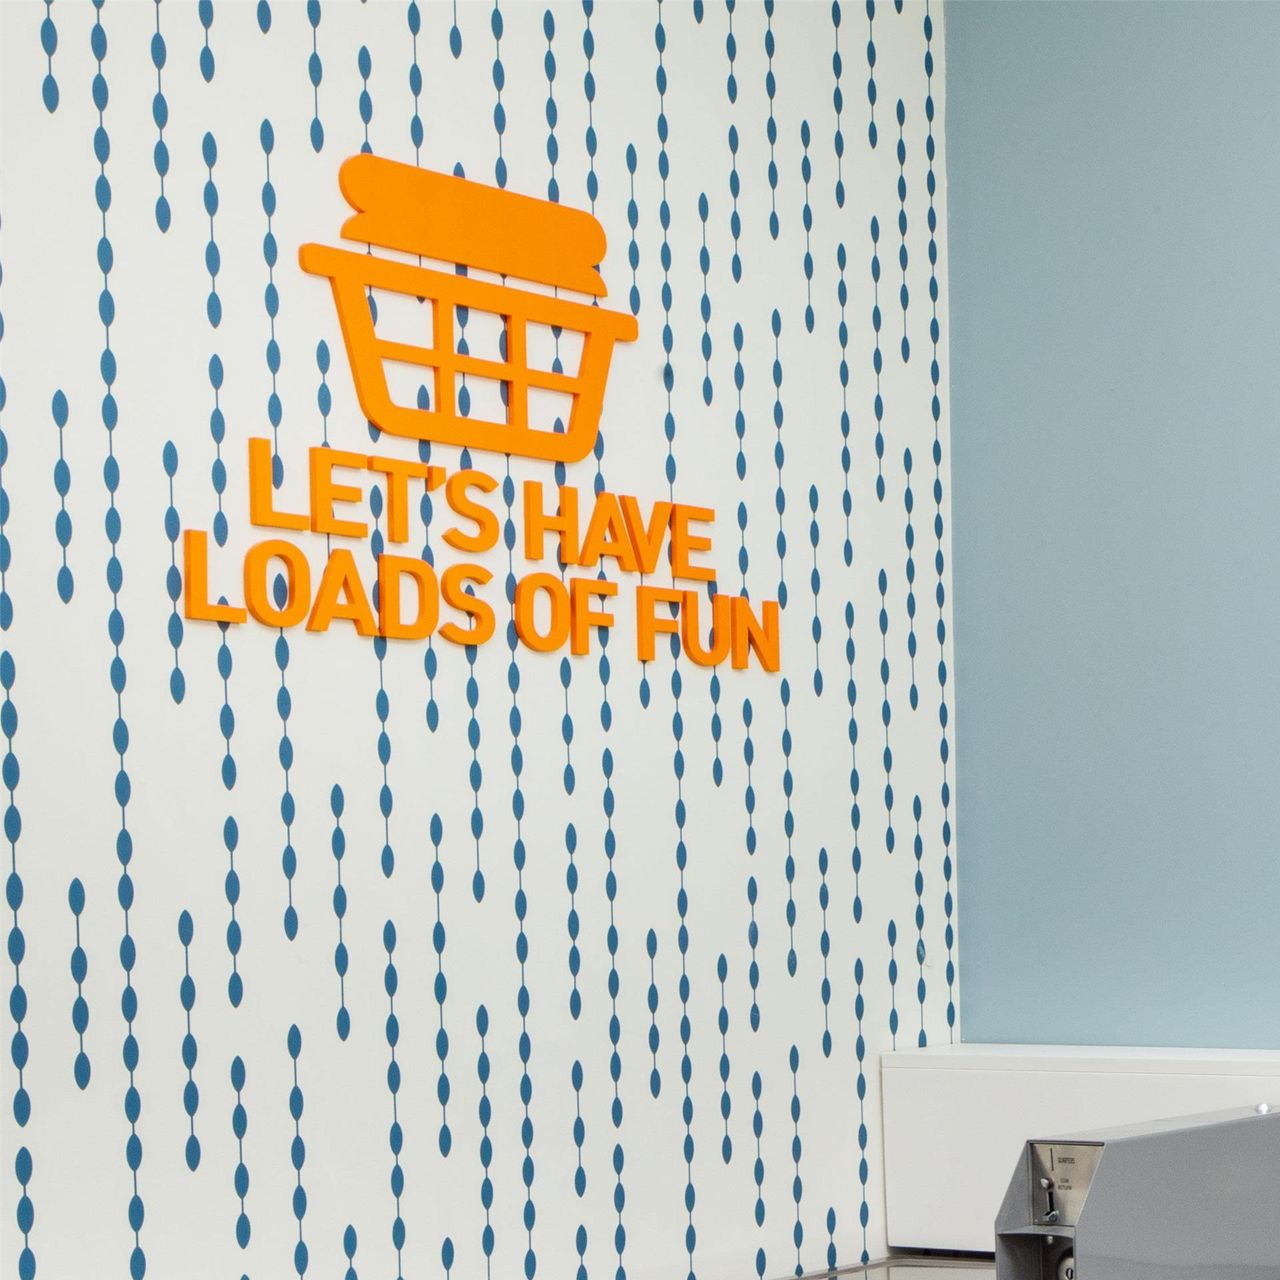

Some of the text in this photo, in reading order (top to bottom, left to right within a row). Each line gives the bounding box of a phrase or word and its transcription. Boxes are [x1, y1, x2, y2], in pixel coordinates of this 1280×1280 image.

[248, 437, 716, 581] LET'S HAVE
[183, 528, 780, 672] LOADS OF FUN
